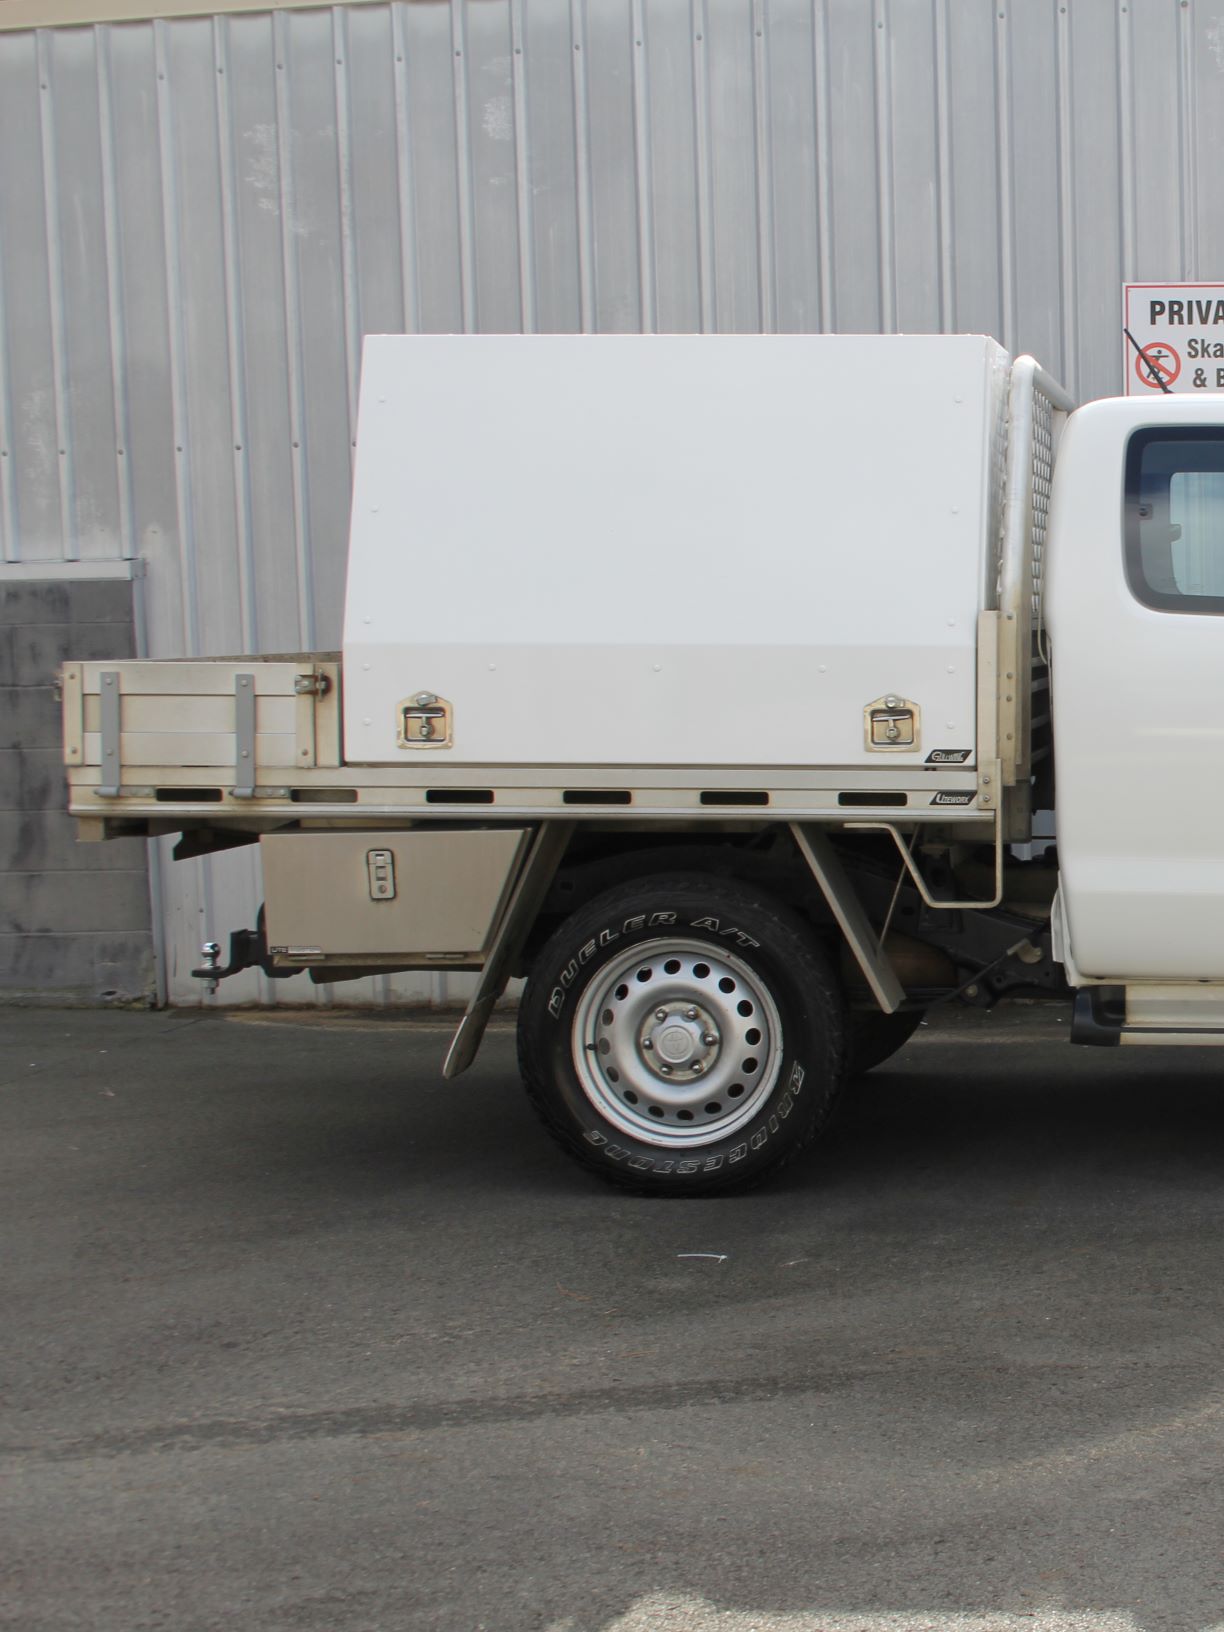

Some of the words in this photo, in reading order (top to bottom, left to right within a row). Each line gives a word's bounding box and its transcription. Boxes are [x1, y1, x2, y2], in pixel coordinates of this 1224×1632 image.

[1192, 368, 1208, 388] &
[548, 911, 678, 1019] DUELER
[690, 916, 761, 949] A/T
[583, 1059, 805, 1174] BRIDGESTONE
